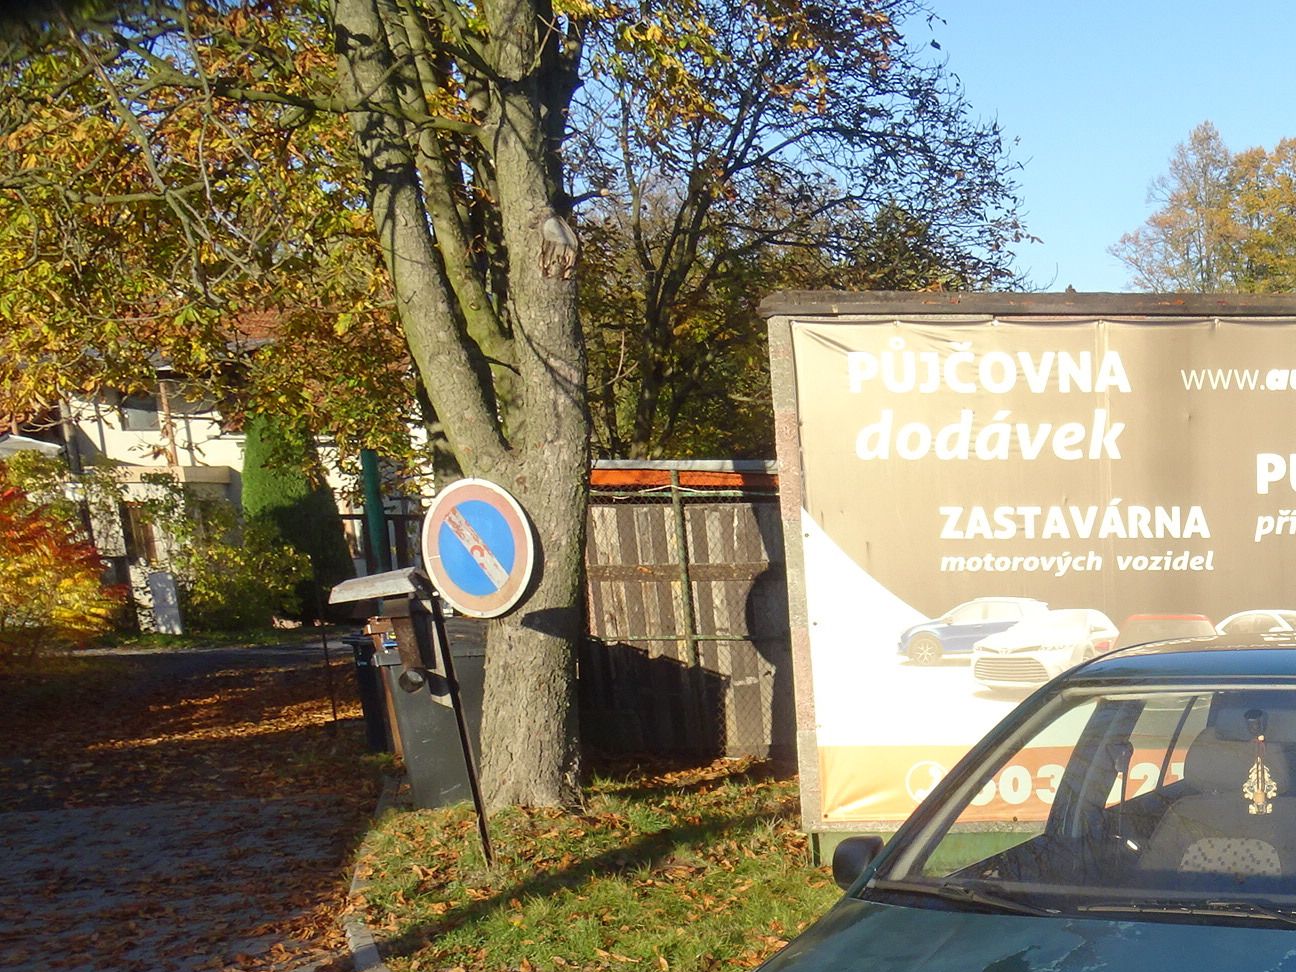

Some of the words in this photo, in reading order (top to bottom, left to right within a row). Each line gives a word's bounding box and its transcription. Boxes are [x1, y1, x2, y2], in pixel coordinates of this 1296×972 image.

[846, 337, 1131, 394] PŮJČOVNA
[855, 408, 1126, 461] dodávek
[938, 497, 1211, 539] ZASTAVÁRNA
[940, 550, 1102, 577] motorových
[1117, 551, 1214, 572] vozidel
